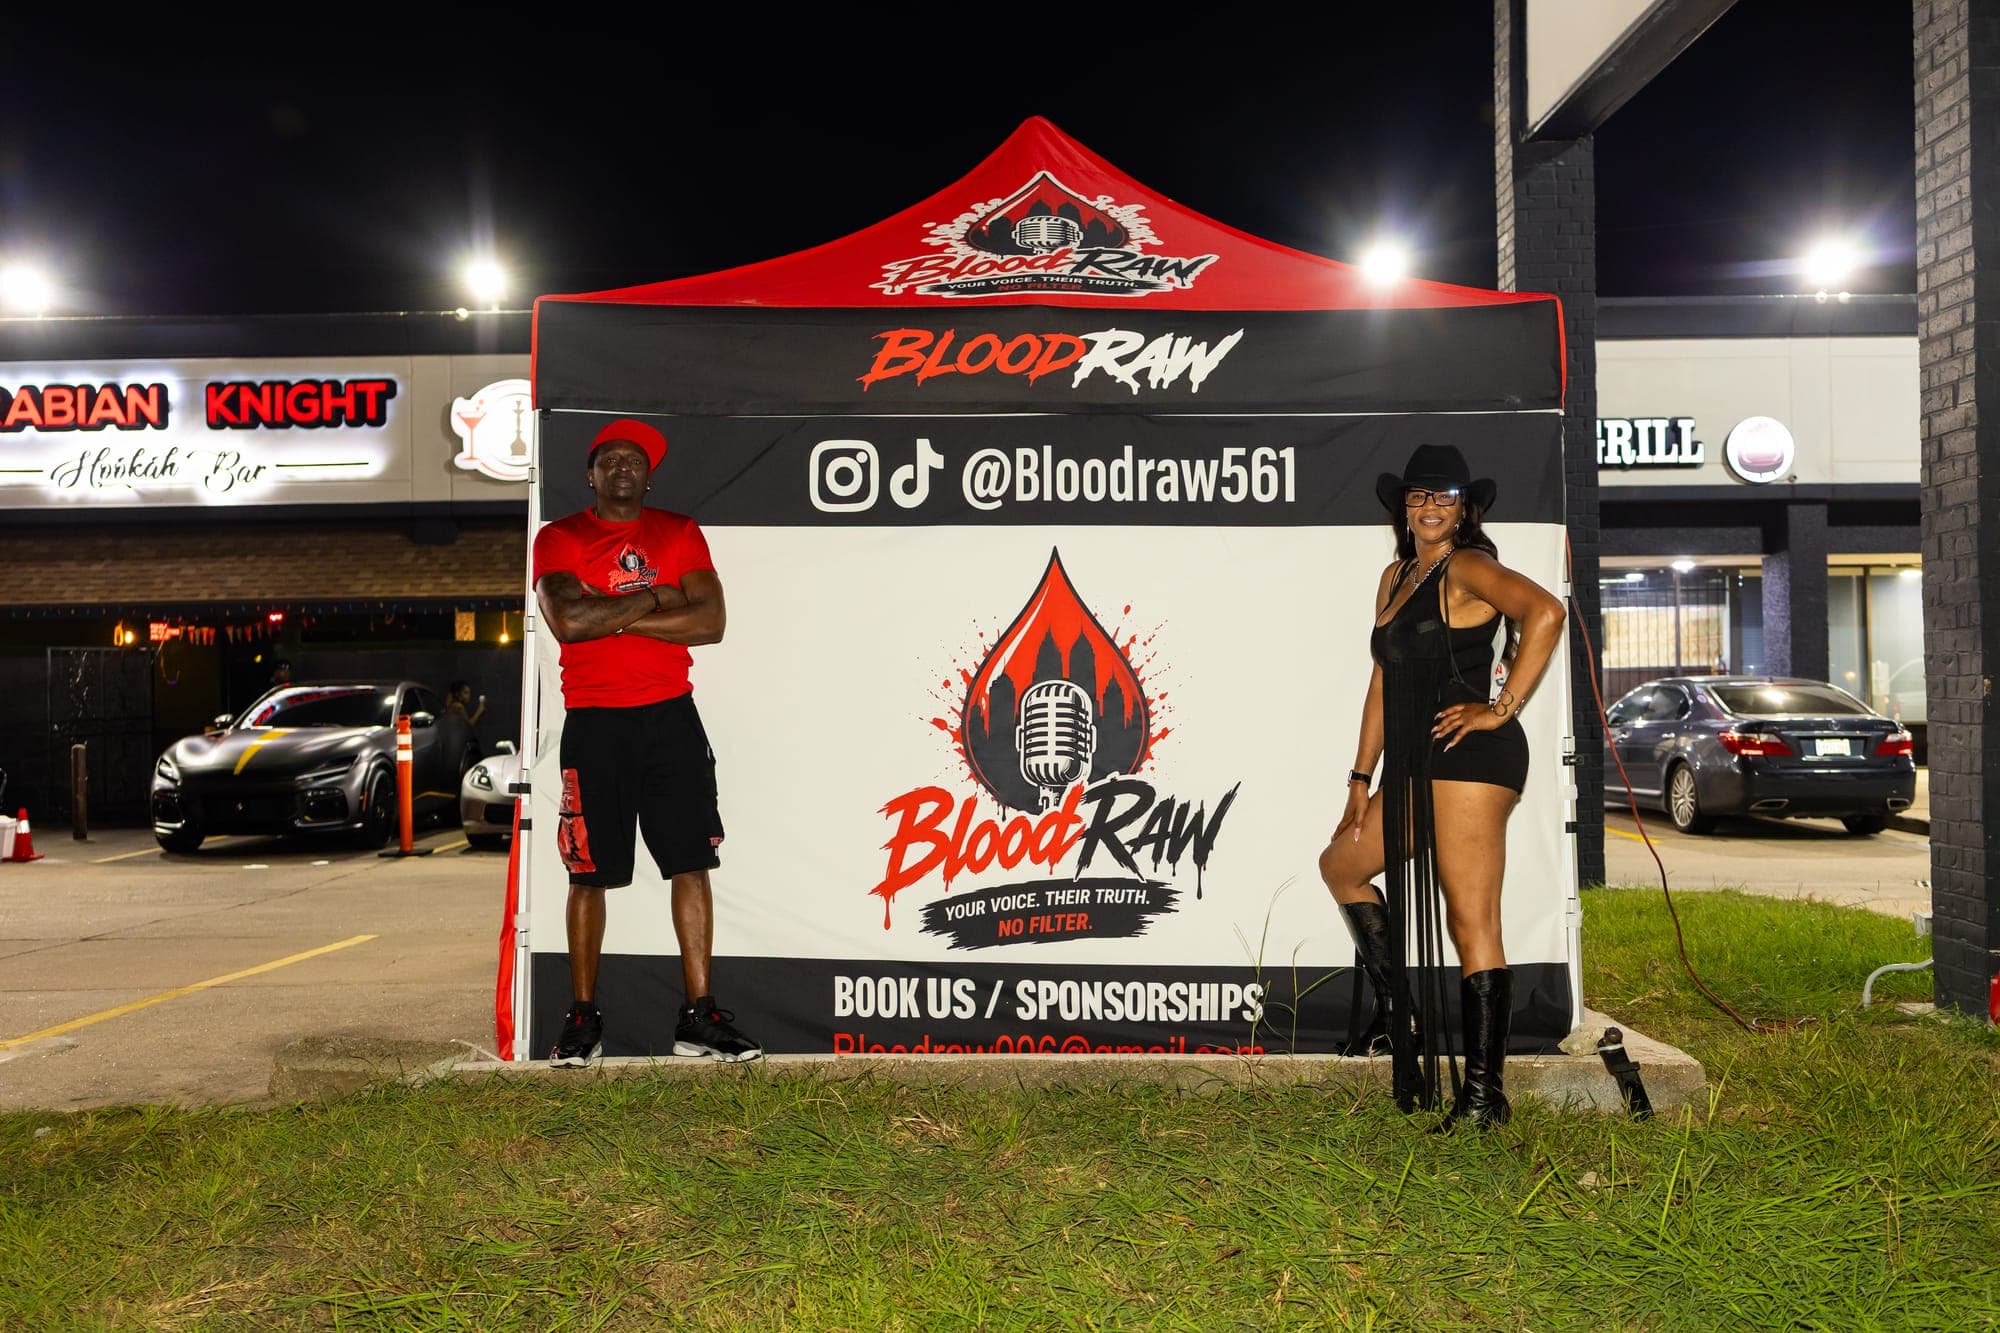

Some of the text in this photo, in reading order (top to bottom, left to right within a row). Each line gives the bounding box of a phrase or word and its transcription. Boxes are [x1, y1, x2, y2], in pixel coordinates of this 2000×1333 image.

[947, 281, 985, 289] YOUR
[990, 276, 1036, 285] VOICE.
[1087, 279, 1138, 287] TRUTH.
[0, 381, 389, 428] ABIAN KNIGHT
[50, 446, 267, 493] Hookah Bar
[962, 445, 1295, 511] @Bloodraw561
[945, 889, 1150, 921] YOUR VOICE. THEIR TRUTH.
[998, 913, 1093, 937] NO FILTER.
[834, 976, 1265, 1023] BOOK US / SPONSORSHIPS
